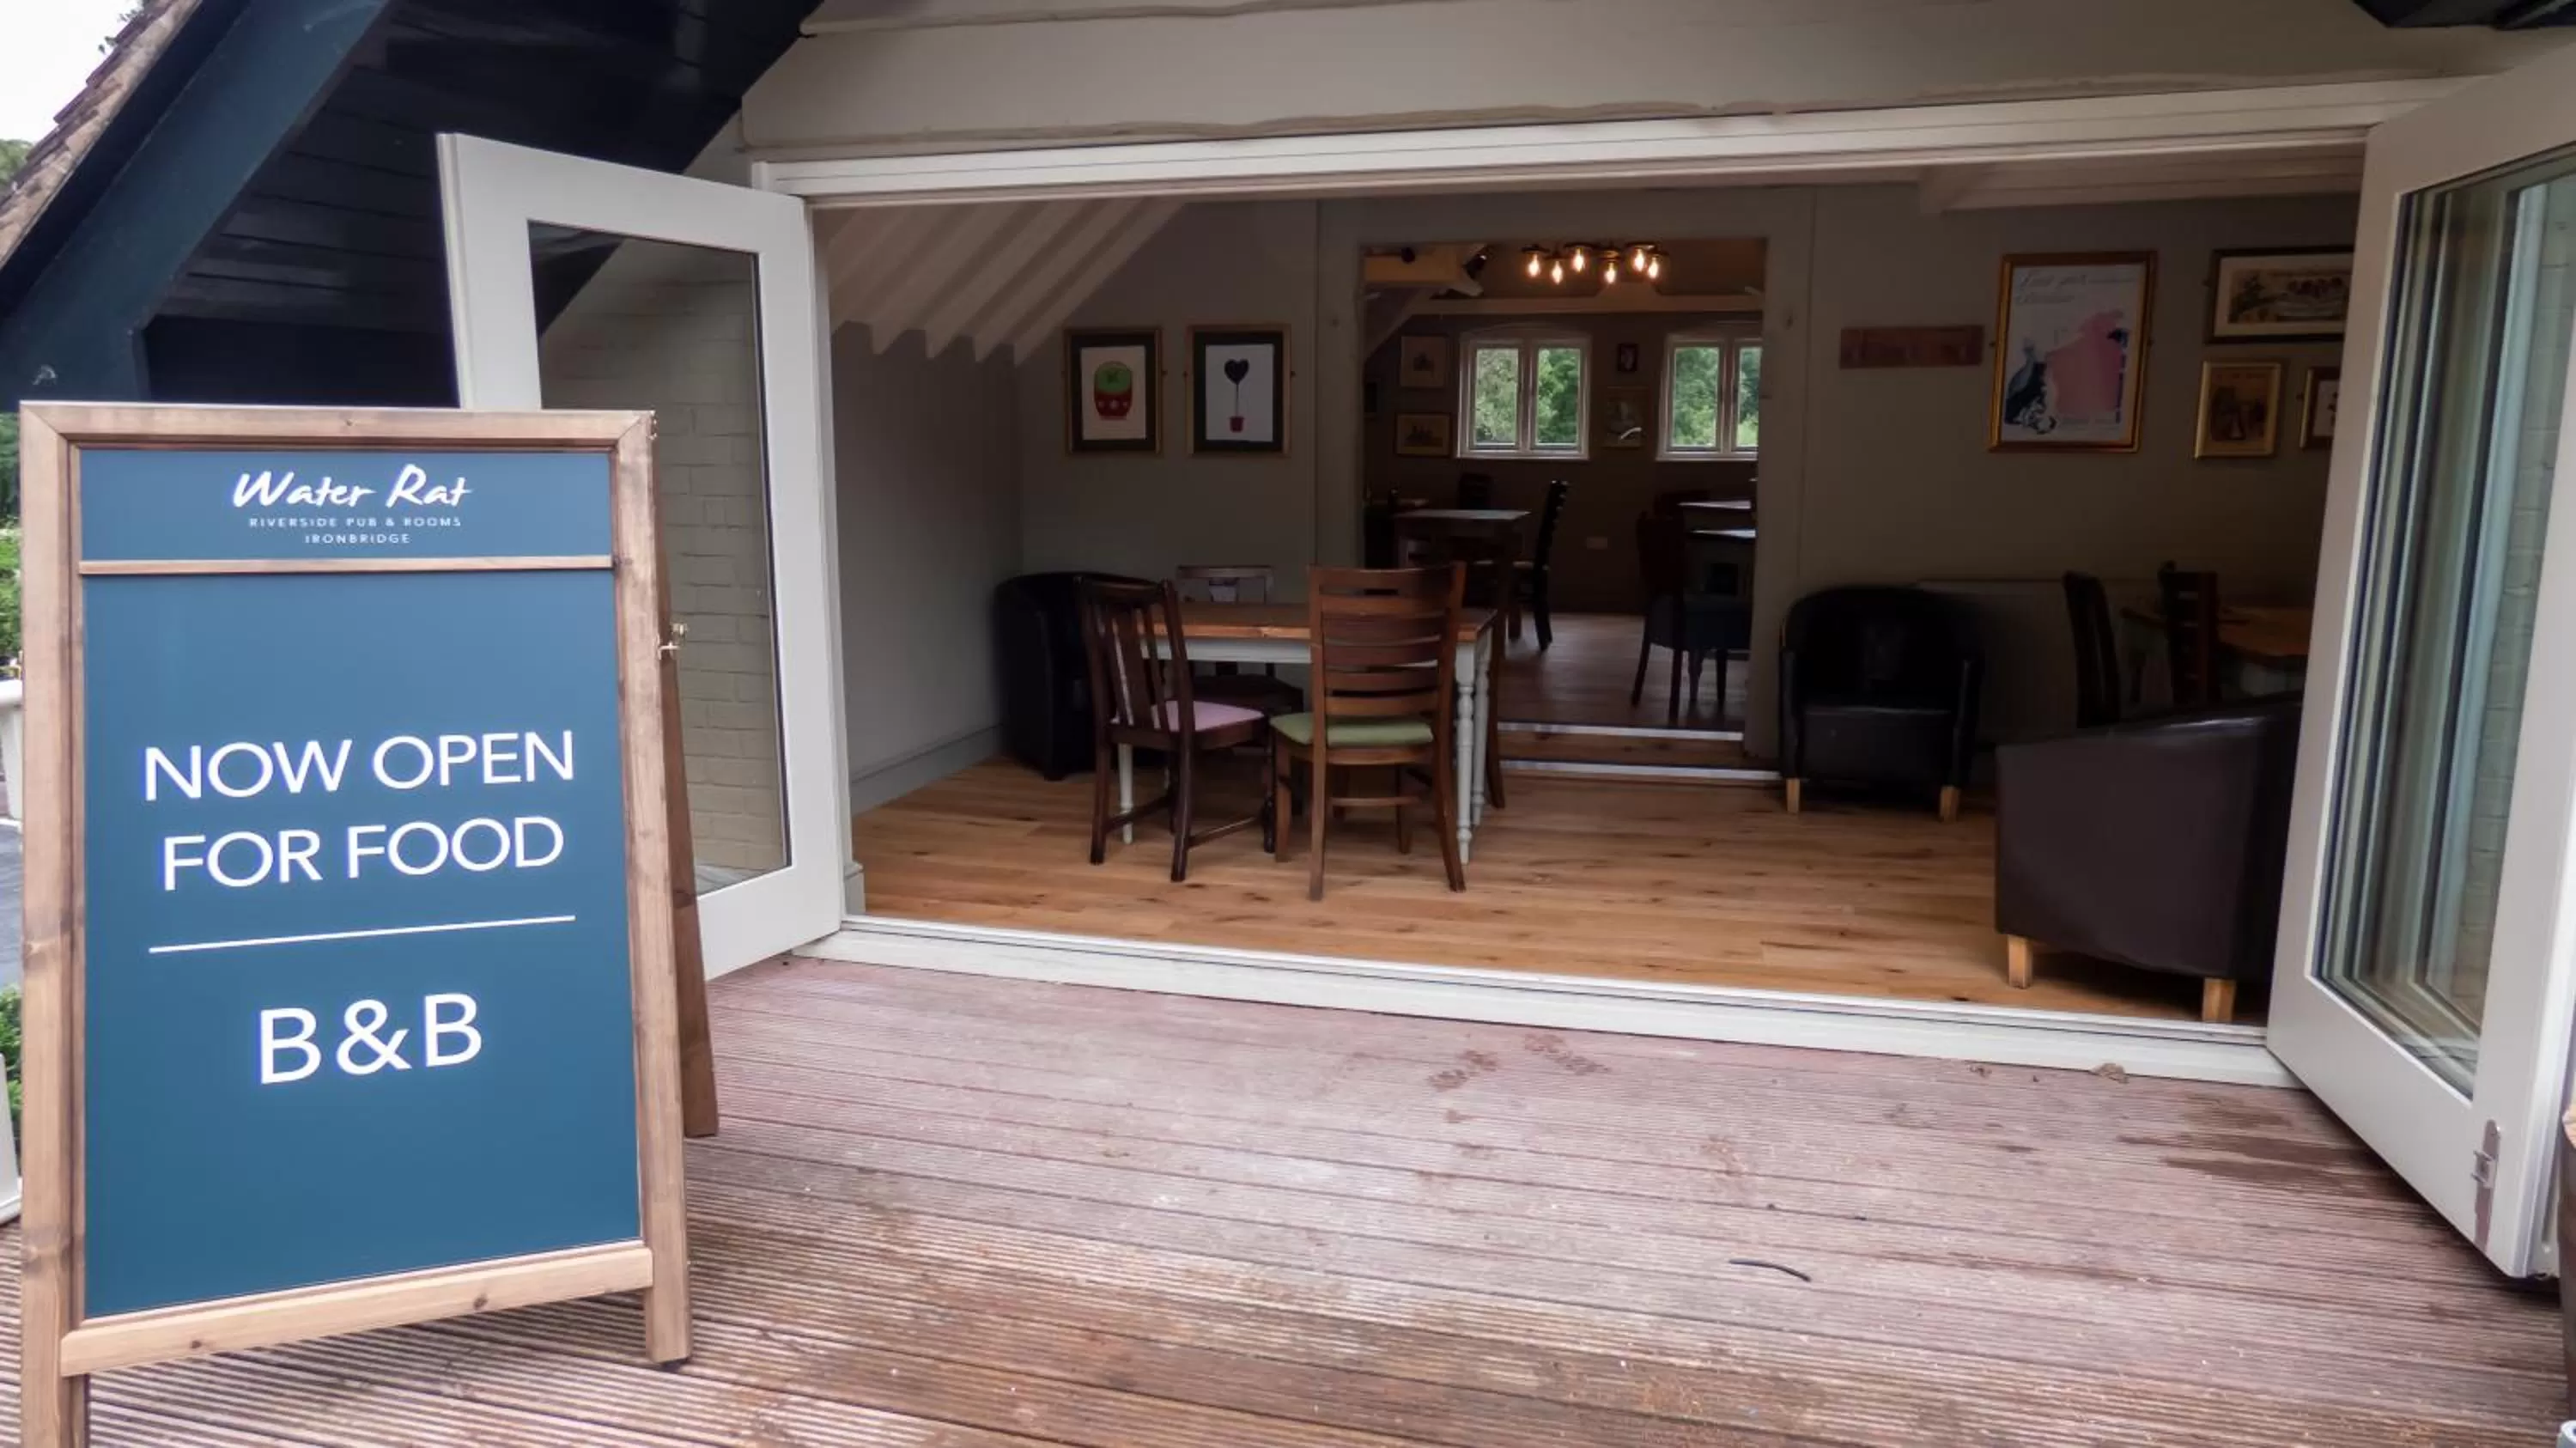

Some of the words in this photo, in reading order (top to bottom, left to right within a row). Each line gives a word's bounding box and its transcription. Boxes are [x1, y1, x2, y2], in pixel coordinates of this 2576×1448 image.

[232, 471, 377, 508] Water
[385, 463, 474, 508] Rat
[248, 517, 337, 528] RIVERSIDE
[346, 517, 377, 527] PUB
[384, 517, 396, 527] &
[404, 517, 462, 527] ROOMS
[304, 532, 411, 545] IRONBRIDGE
[144, 739, 352, 801] NOW
[371, 730, 574, 790] OPEN
[164, 829, 323, 891] FOR
[347, 814, 564, 879] FOOD
[259, 992, 483, 1085] B&B
